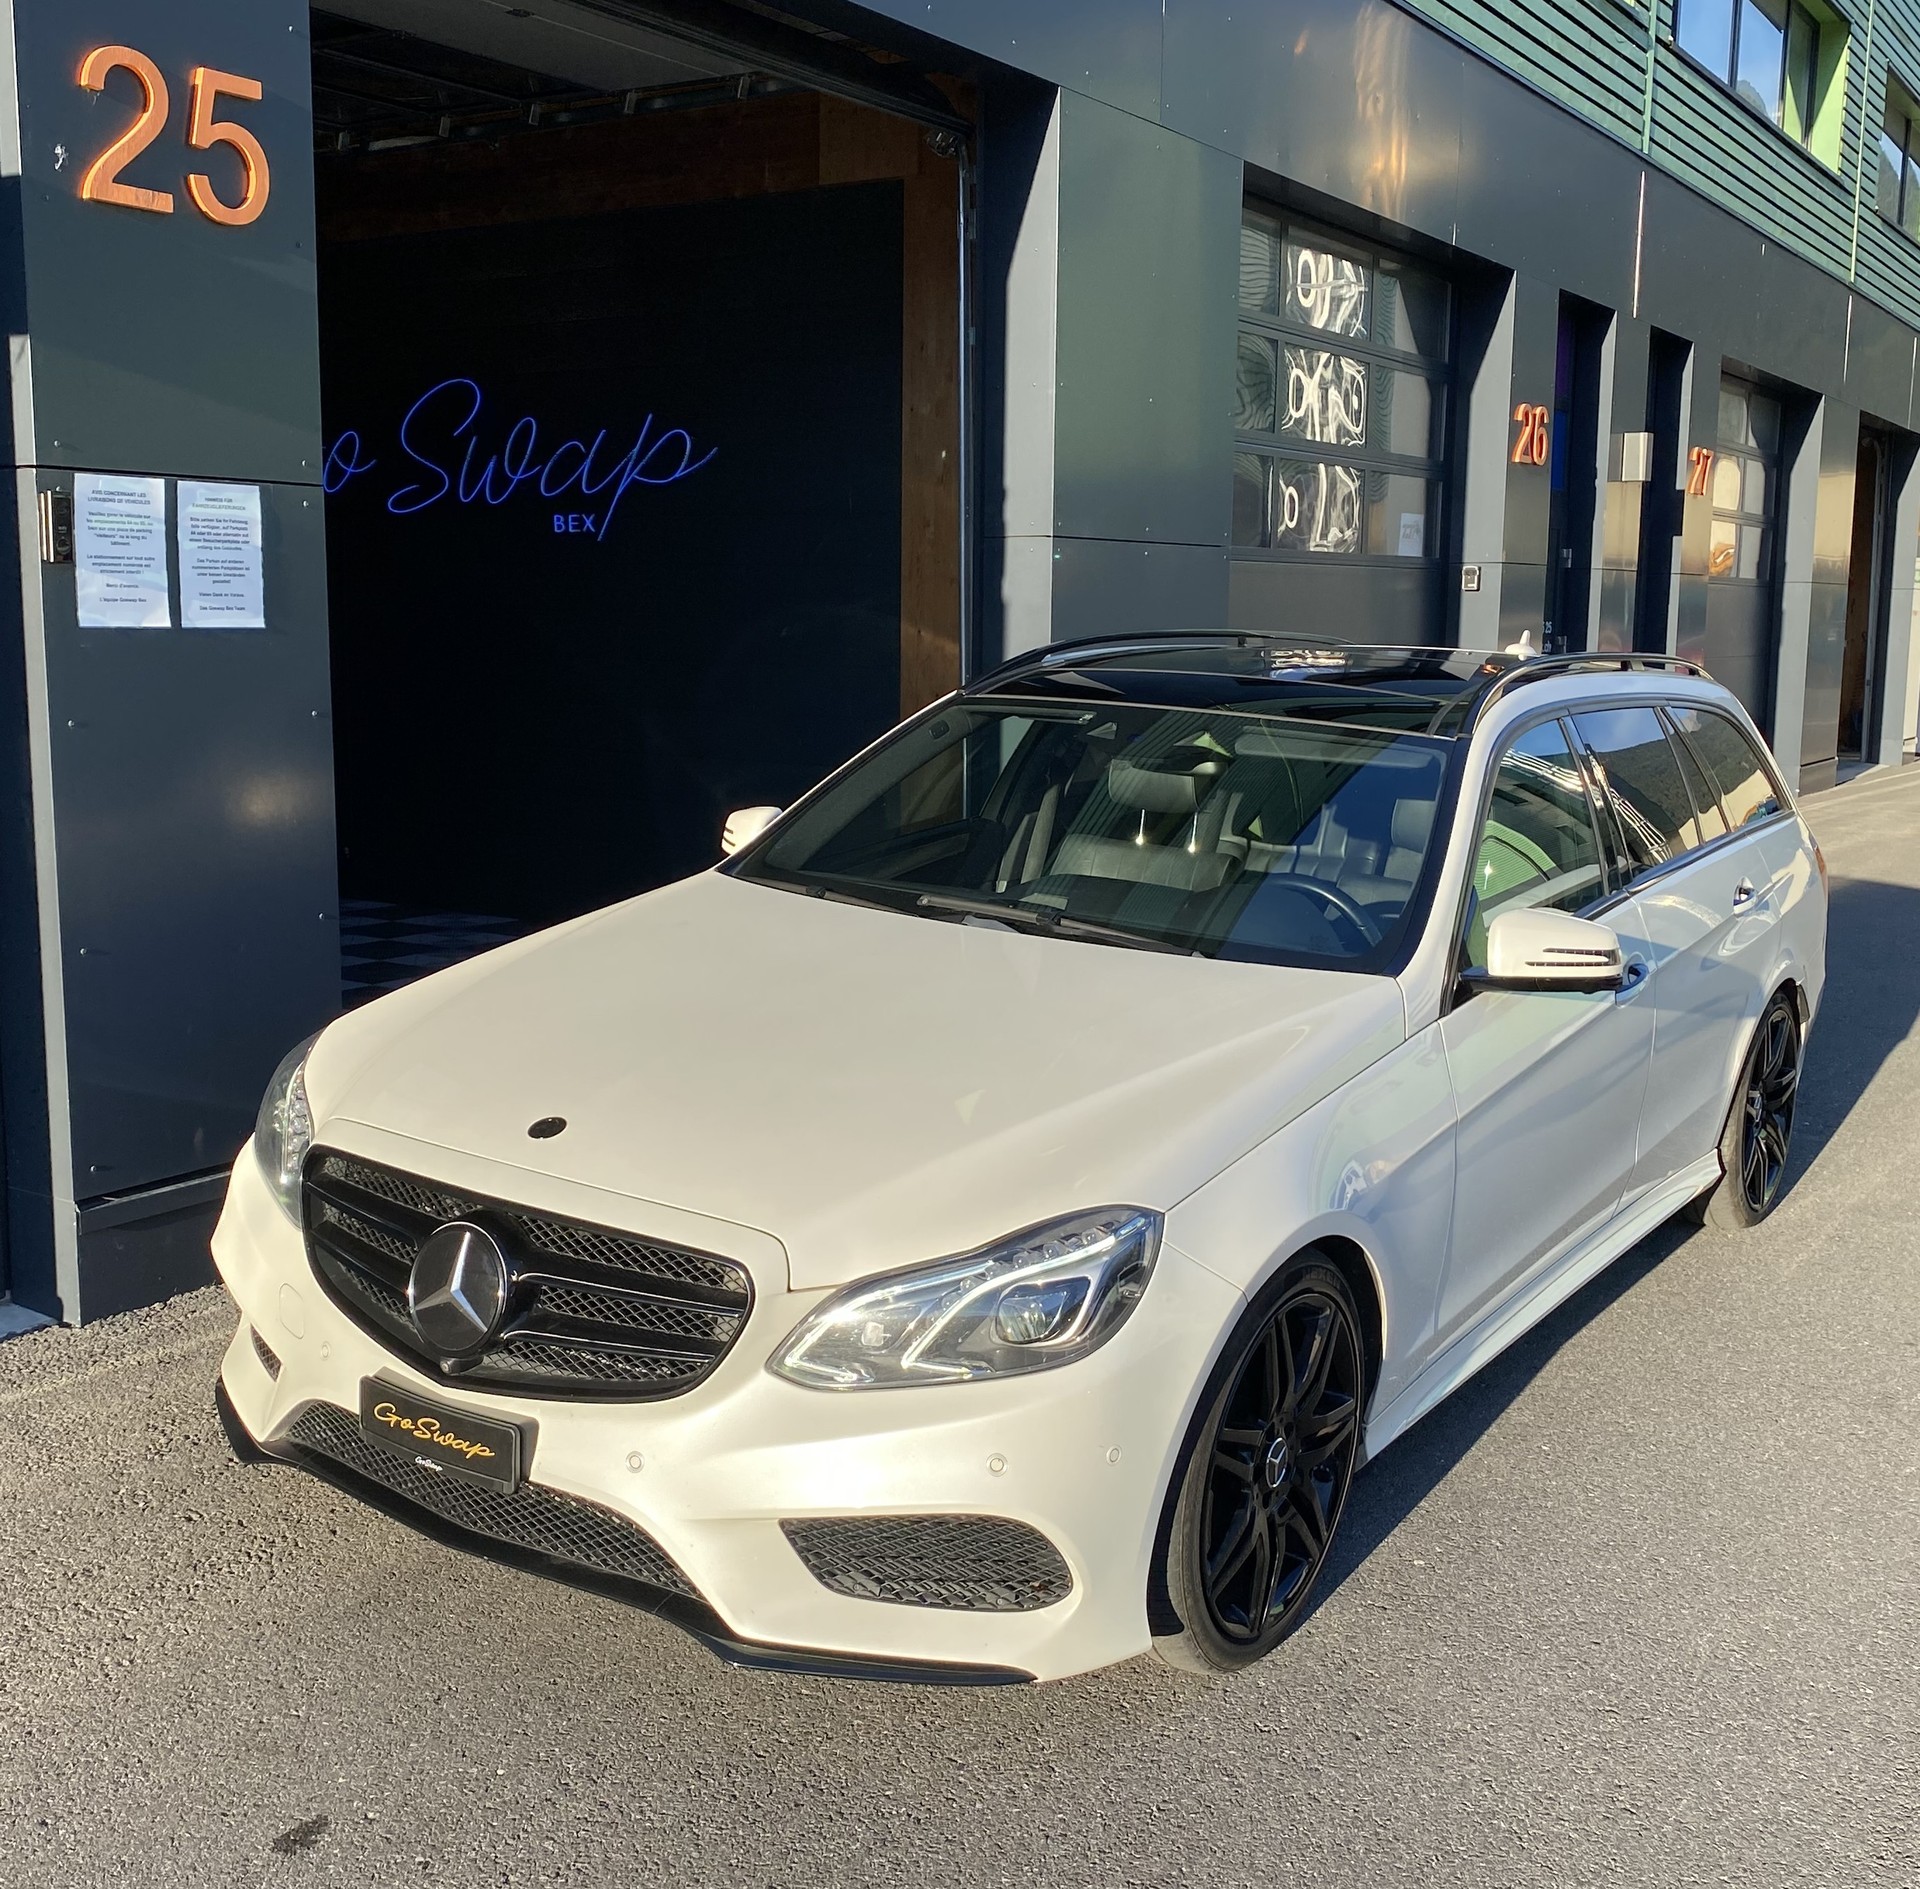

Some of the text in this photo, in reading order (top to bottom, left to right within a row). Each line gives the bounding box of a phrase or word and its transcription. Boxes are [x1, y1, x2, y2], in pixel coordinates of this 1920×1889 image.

[80, 45, 270, 225] 25
[323, 379, 718, 541] o Swap
[1511, 402, 1549, 466] 26
[1687, 446, 1714, 495] 27
[553, 514, 597, 533] BEX
[374, 1402, 495, 1459] GoSwap
